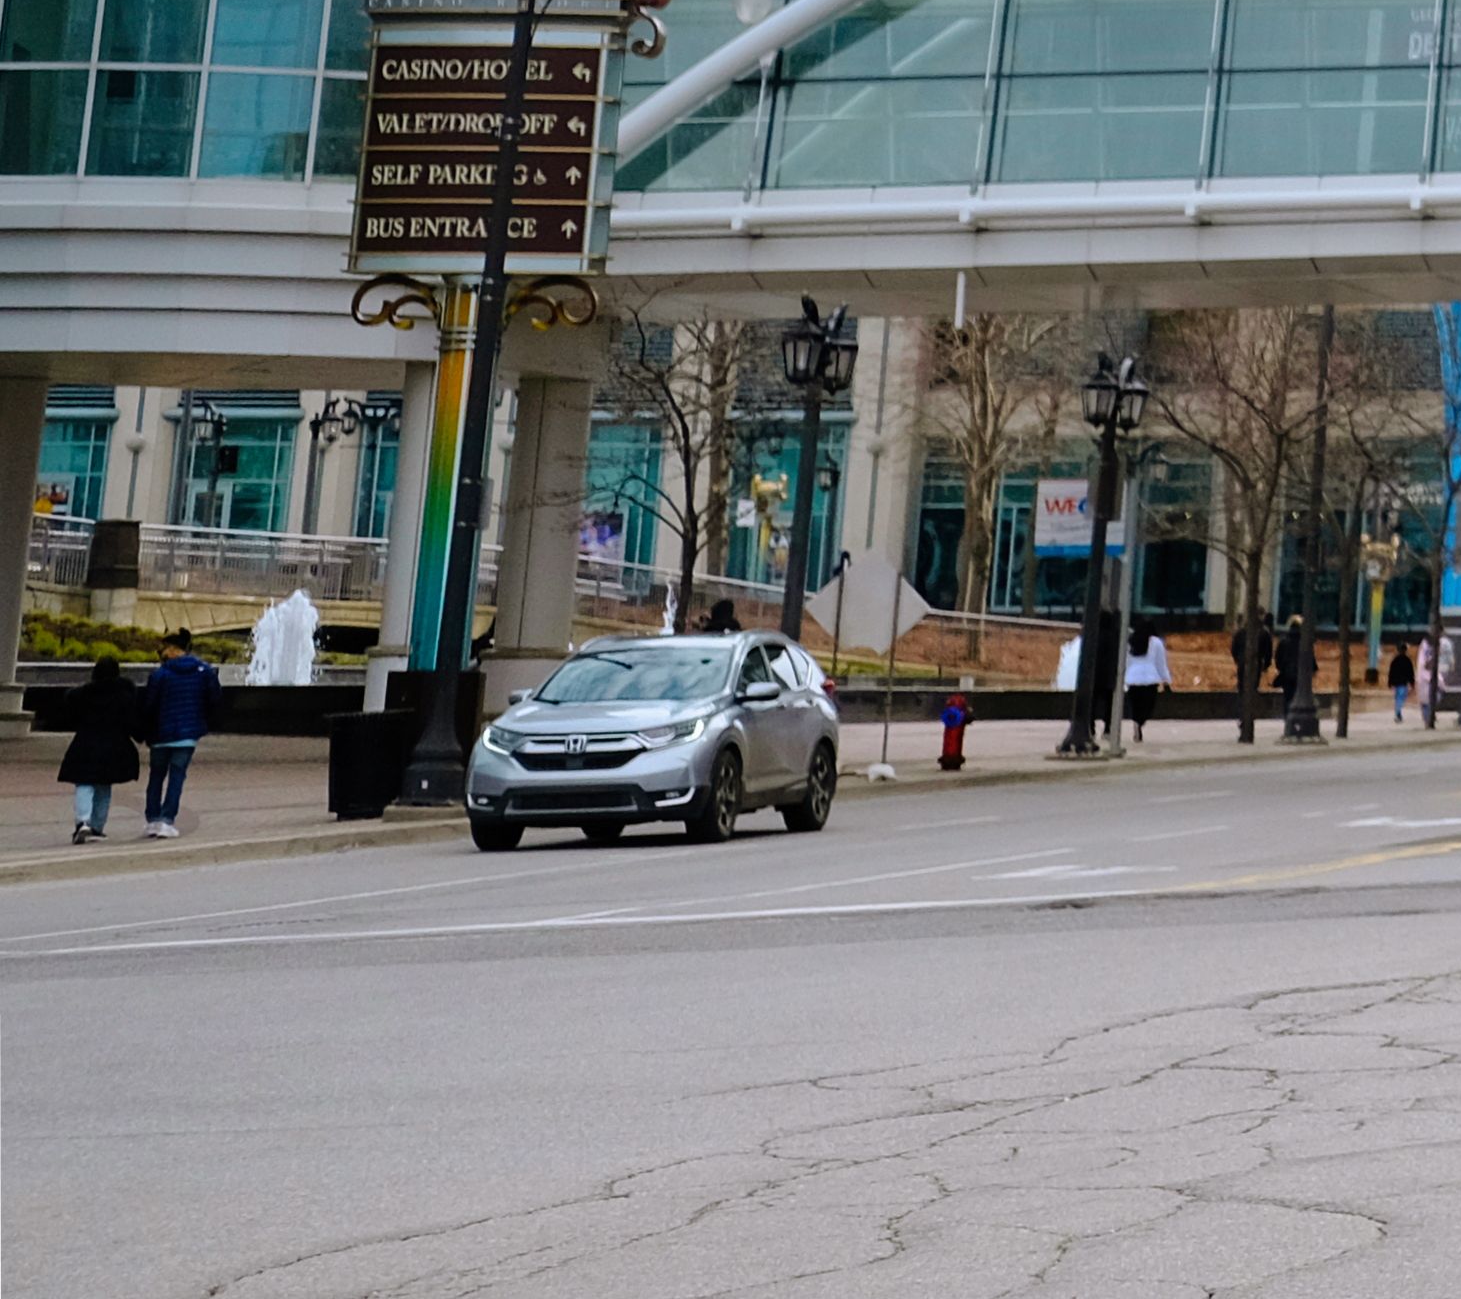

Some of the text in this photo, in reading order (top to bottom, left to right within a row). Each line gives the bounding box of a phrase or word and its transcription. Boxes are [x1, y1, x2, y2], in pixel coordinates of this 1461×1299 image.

[381, 58, 553, 82] CASINO/HOEL
[371, 164, 529, 187] SELF PARKIG
[365, 216, 538, 240] BUS ENTRACE
